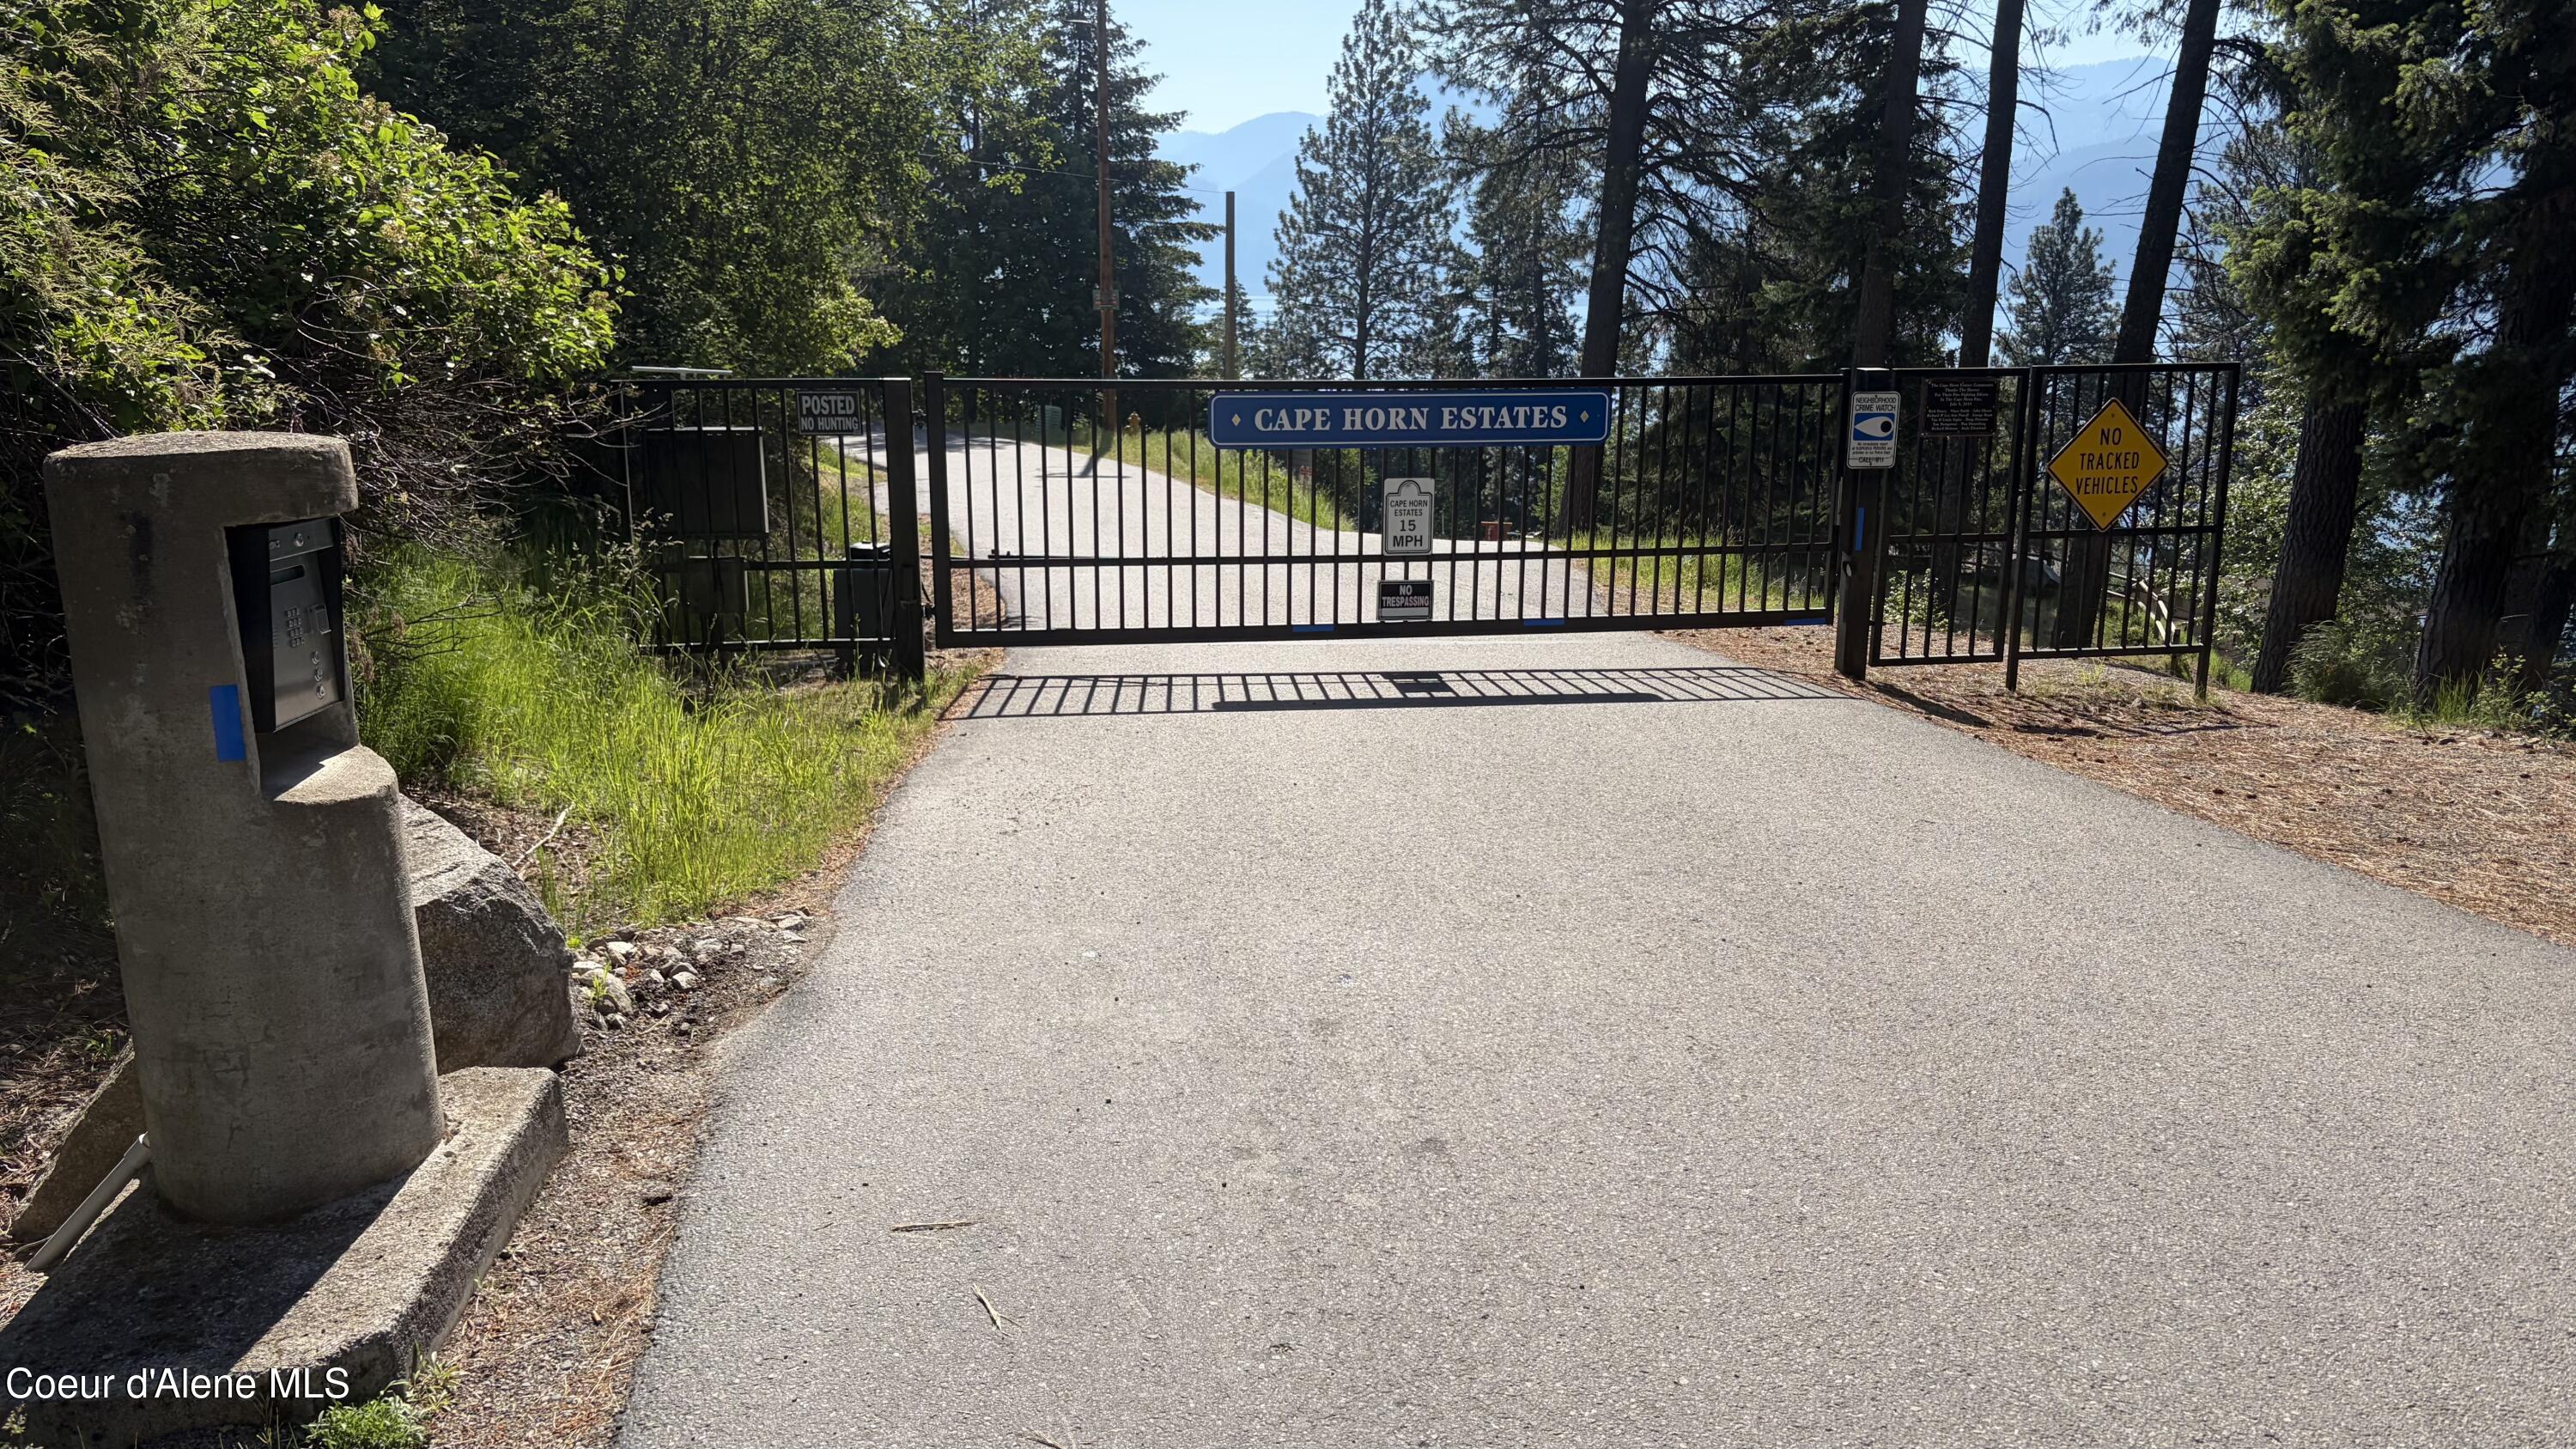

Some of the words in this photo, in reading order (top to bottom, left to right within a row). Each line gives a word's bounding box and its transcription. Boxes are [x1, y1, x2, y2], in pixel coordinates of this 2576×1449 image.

[801, 395, 855, 415] POSTED
[800, 417, 815, 430] NO
[817, 417, 859, 430] HUNTING
[1255, 408, 1331, 431] CAPE
[1342, 407, 1429, 430] HORN
[1440, 405, 1567, 429] ESTATES
[2100, 428, 2122, 446] NO
[2080, 452, 2140, 471] TRACKED
[2075, 476, 2138, 495] VEHICLES
[1400, 520, 1416, 532] 15
[1393, 535, 1423, 547] MPH
[1399, 585, 1413, 595] NO
[1382, 595, 1430, 607] TRESPASSING
